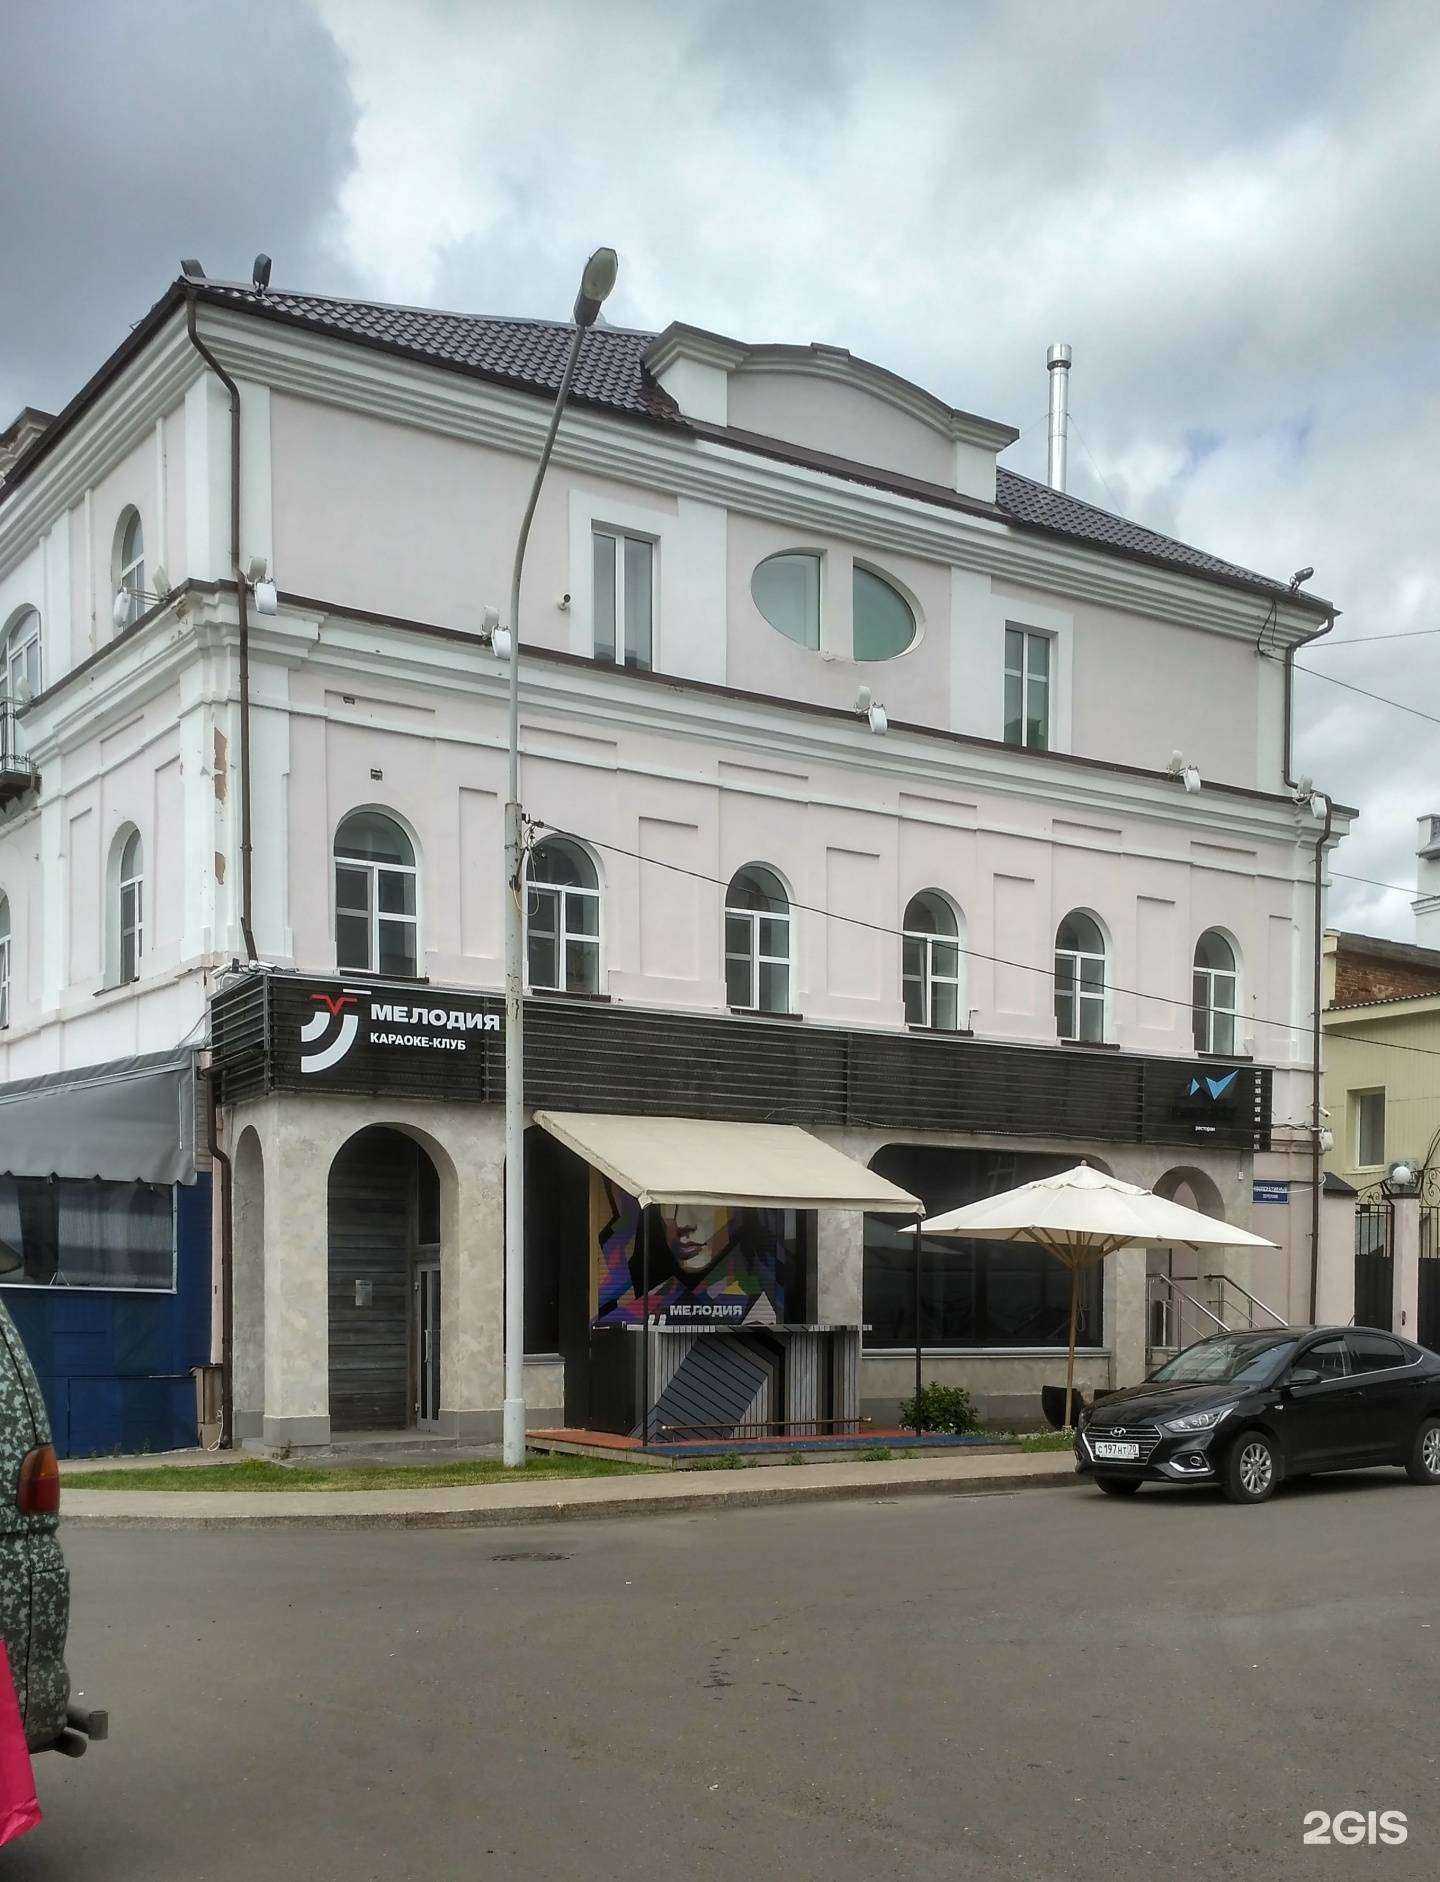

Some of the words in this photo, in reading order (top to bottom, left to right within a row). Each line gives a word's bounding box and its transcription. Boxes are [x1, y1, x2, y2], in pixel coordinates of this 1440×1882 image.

[370, 1003, 500, 1031] МЕЛОДИЯ
[370, 1032, 467, 1050] КАРАОКЕ-КЛУБ
[669, 1304, 743, 1318] МЕЛОДИЯ
